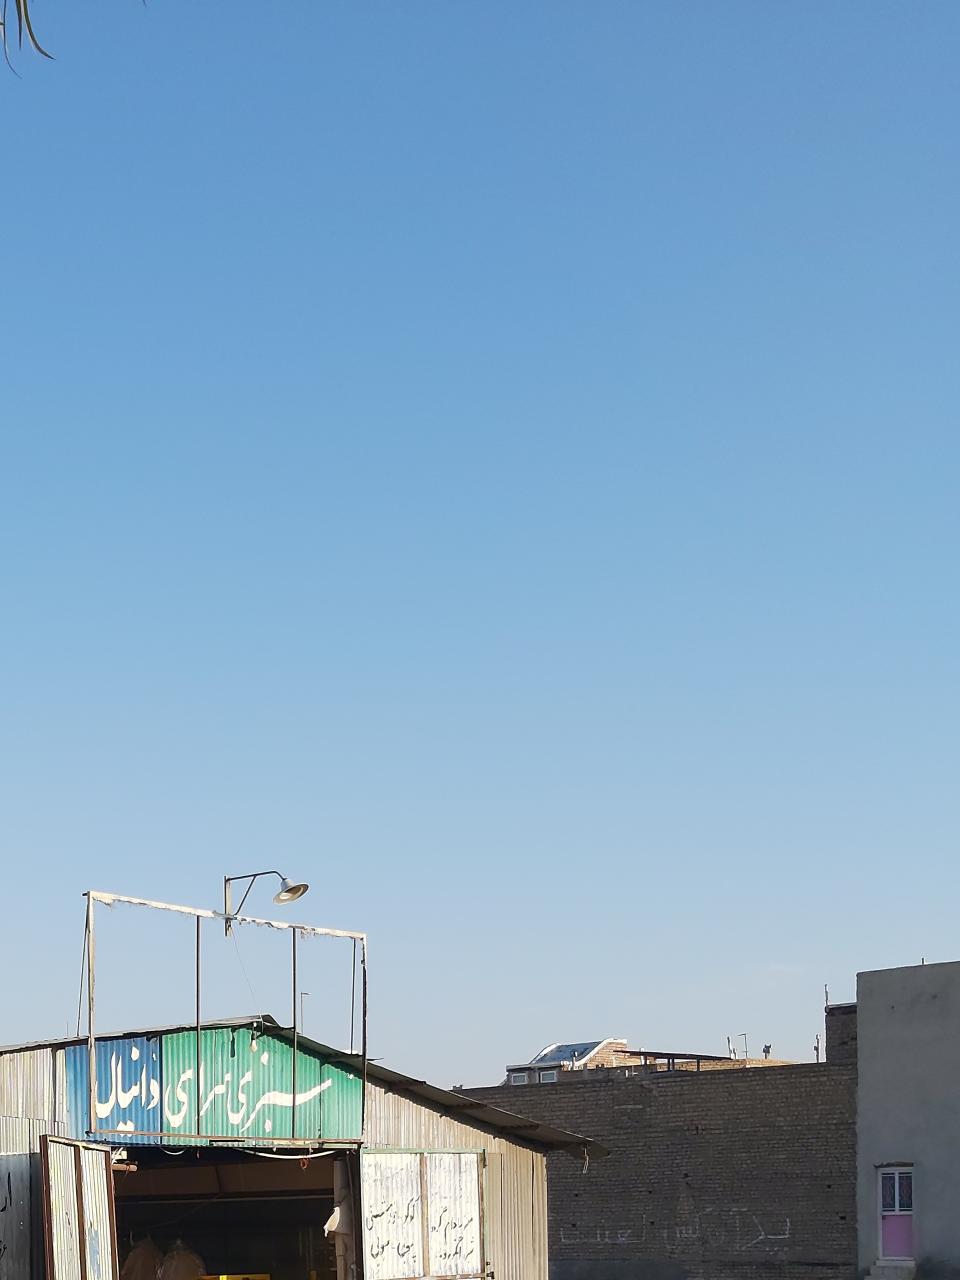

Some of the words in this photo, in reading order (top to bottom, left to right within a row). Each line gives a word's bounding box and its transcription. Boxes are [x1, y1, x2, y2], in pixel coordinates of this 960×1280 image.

[95, 1046, 160, 1137] دانیال
[165, 1062, 230, 1128] سرای
[227, 1051, 332, 1132] سبزی
